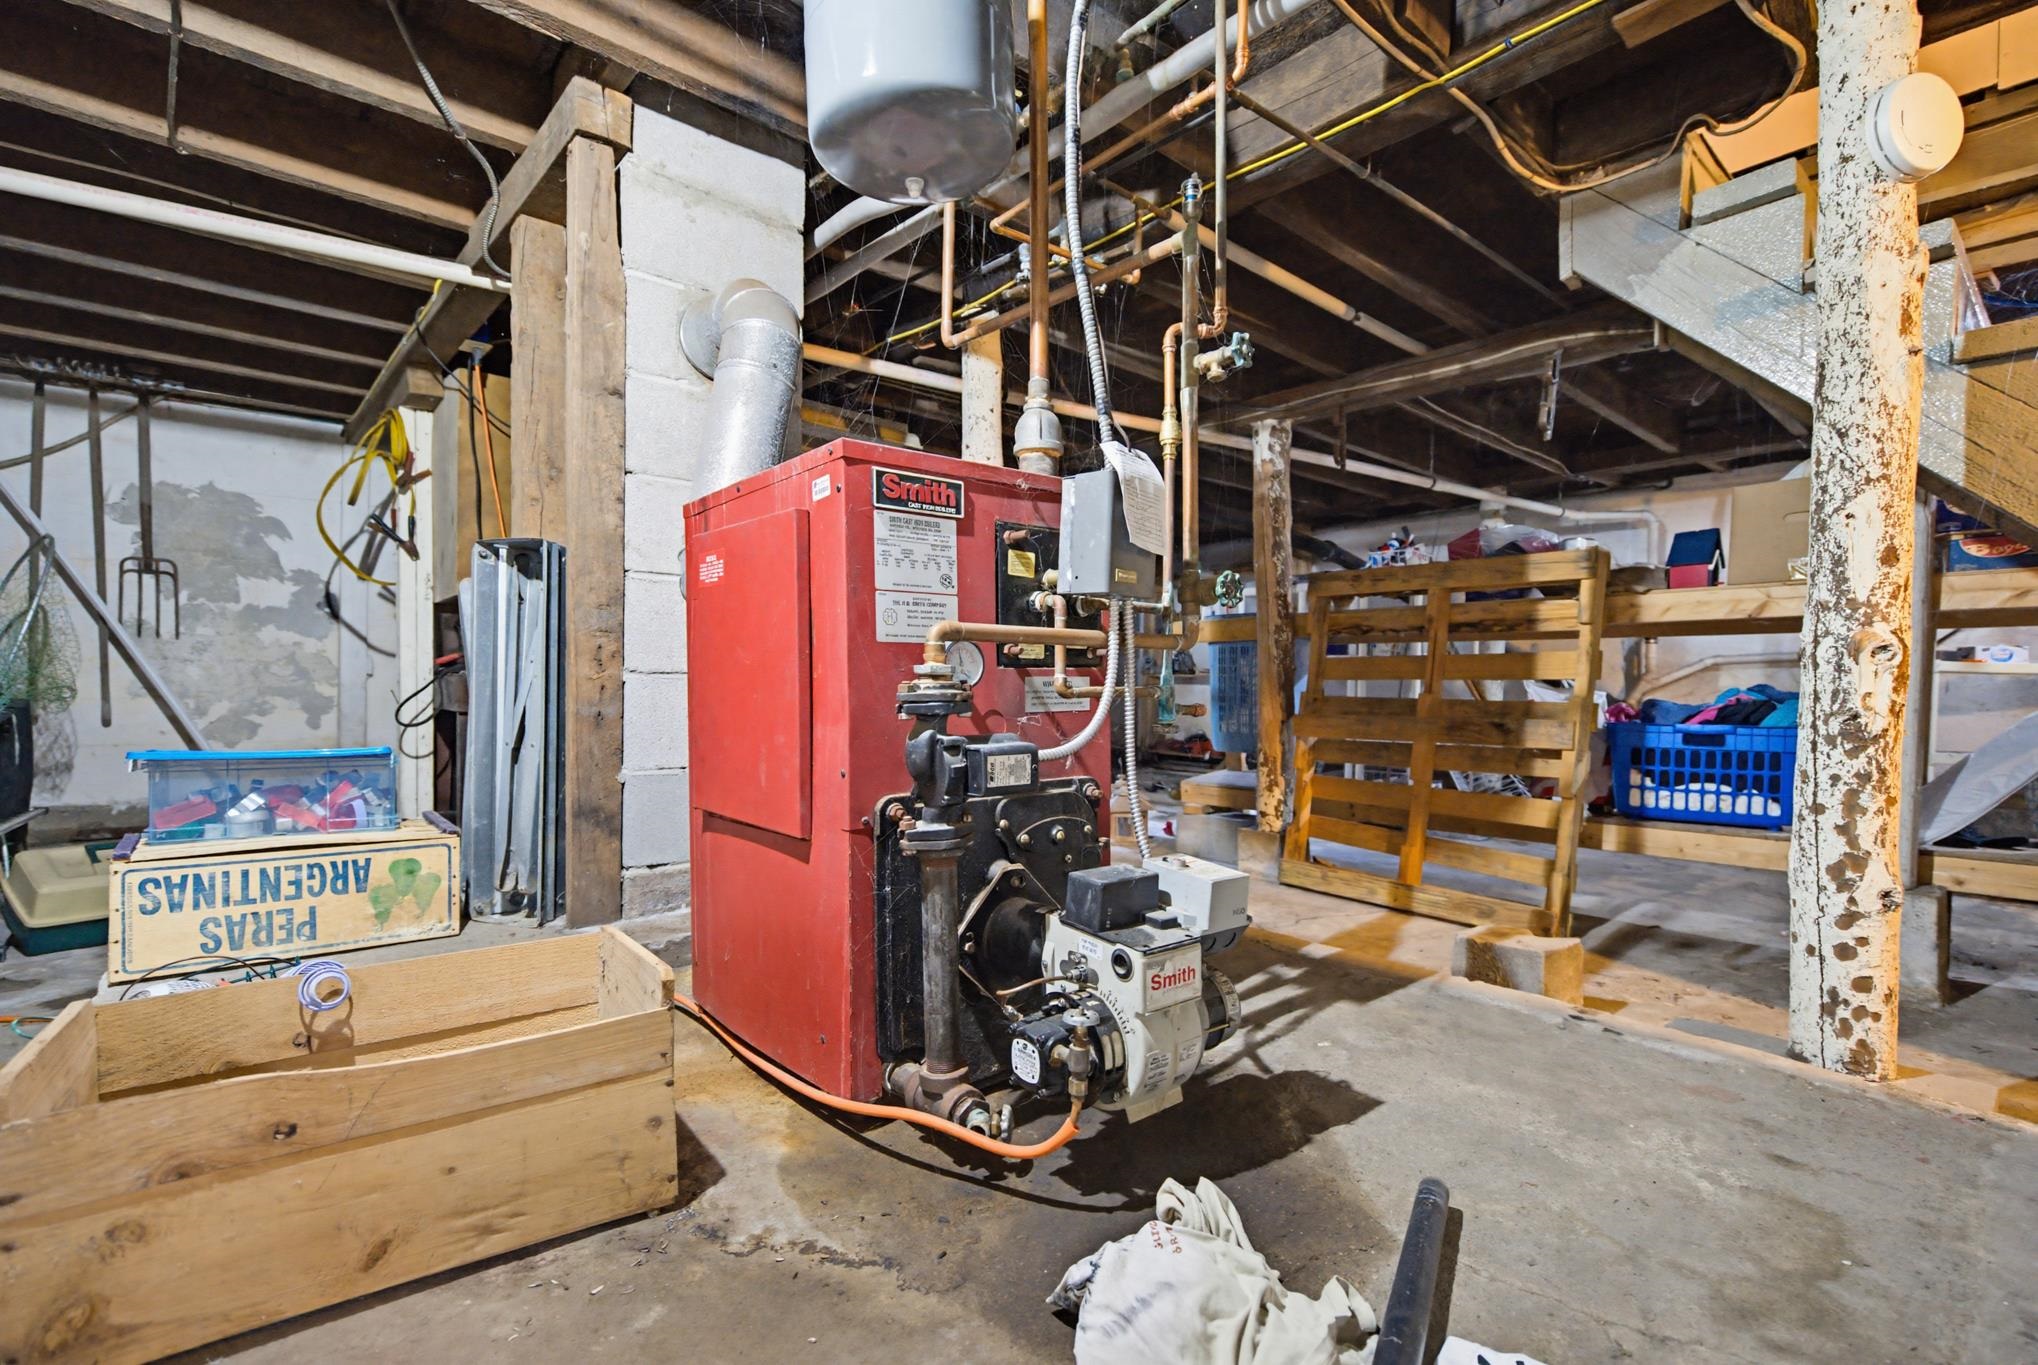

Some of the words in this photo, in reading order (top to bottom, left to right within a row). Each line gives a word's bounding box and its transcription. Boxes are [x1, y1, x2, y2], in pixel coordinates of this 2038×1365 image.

[882, 473, 956, 506] Smith
[137, 857, 371, 916] ARGENTINAS
[199, 905, 317, 954] PERAS
[1151, 966, 1196, 991] Smith
